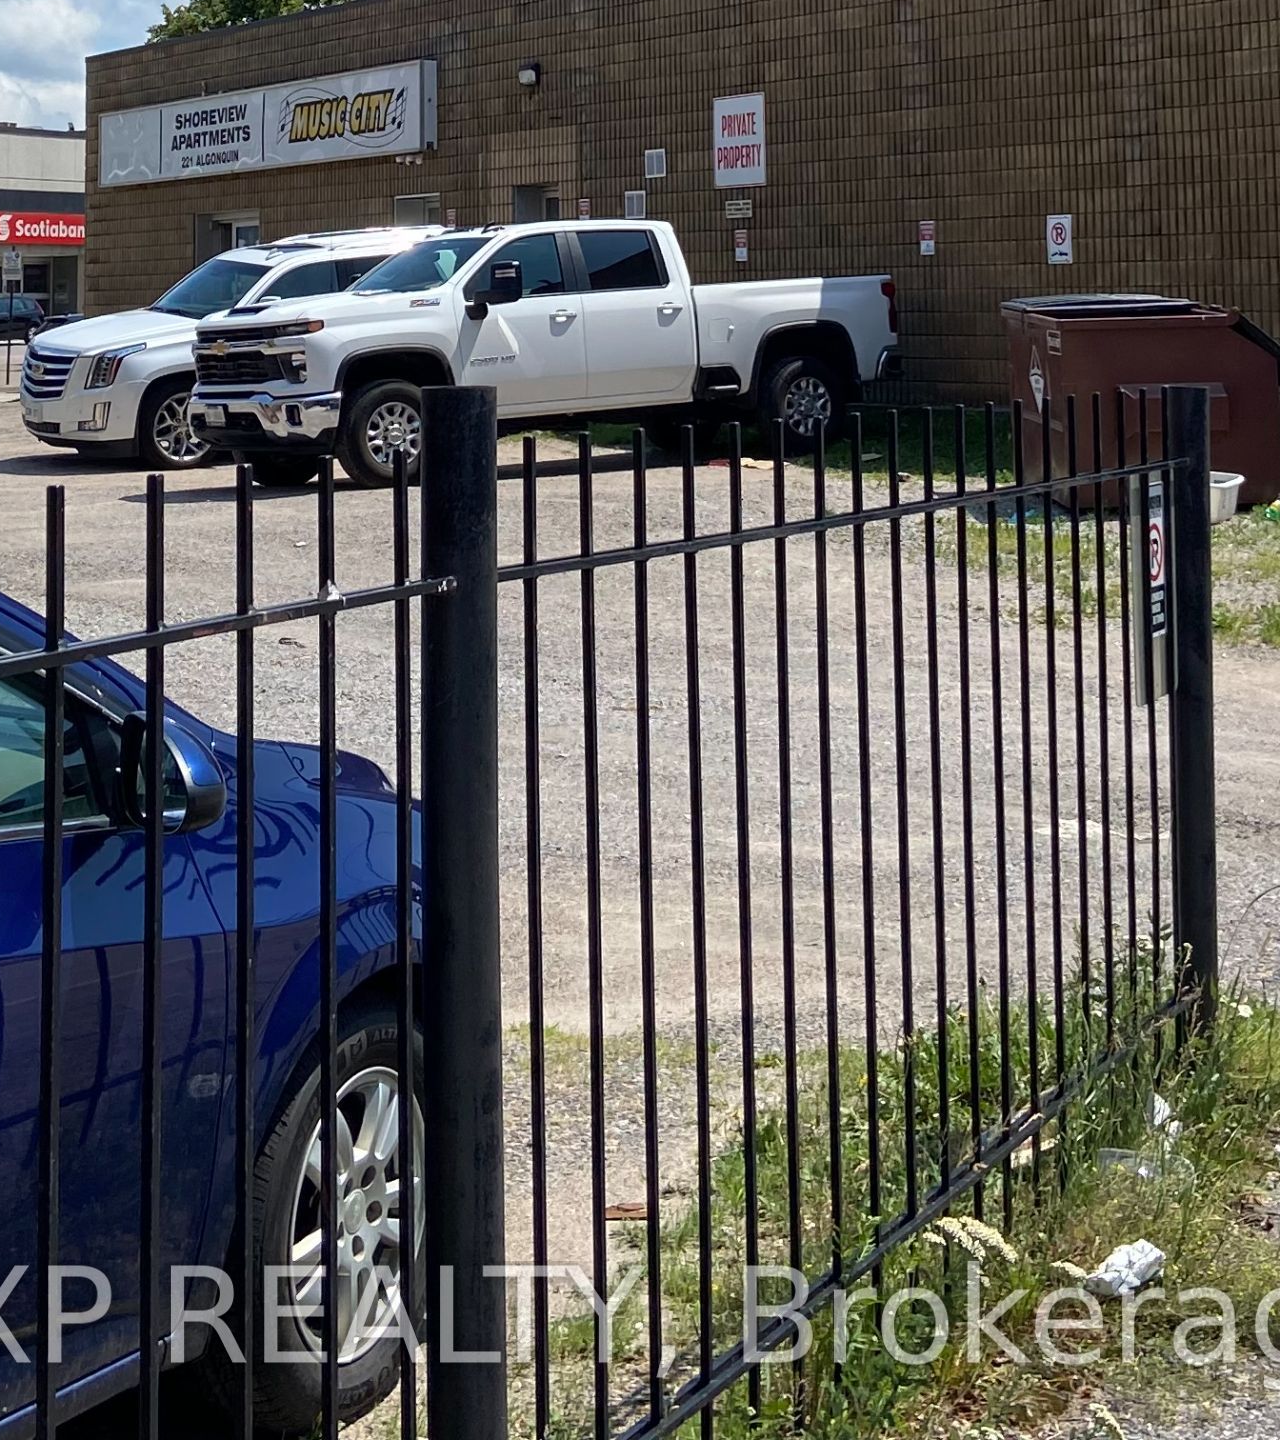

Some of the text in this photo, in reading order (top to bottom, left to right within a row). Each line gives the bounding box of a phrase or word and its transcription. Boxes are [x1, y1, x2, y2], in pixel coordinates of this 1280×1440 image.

[175, 104, 248, 130] SHOREVIEW
[288, 88, 395, 143] MUSIC CITY
[721, 112, 757, 138] PRIVATE
[171, 125, 251, 151] APARTMENTS
[181, 149, 239, 168] 221 ALGONQUIN
[717, 143, 762, 171] PROPERTY
[15, 219, 86, 238] Scotiaban
